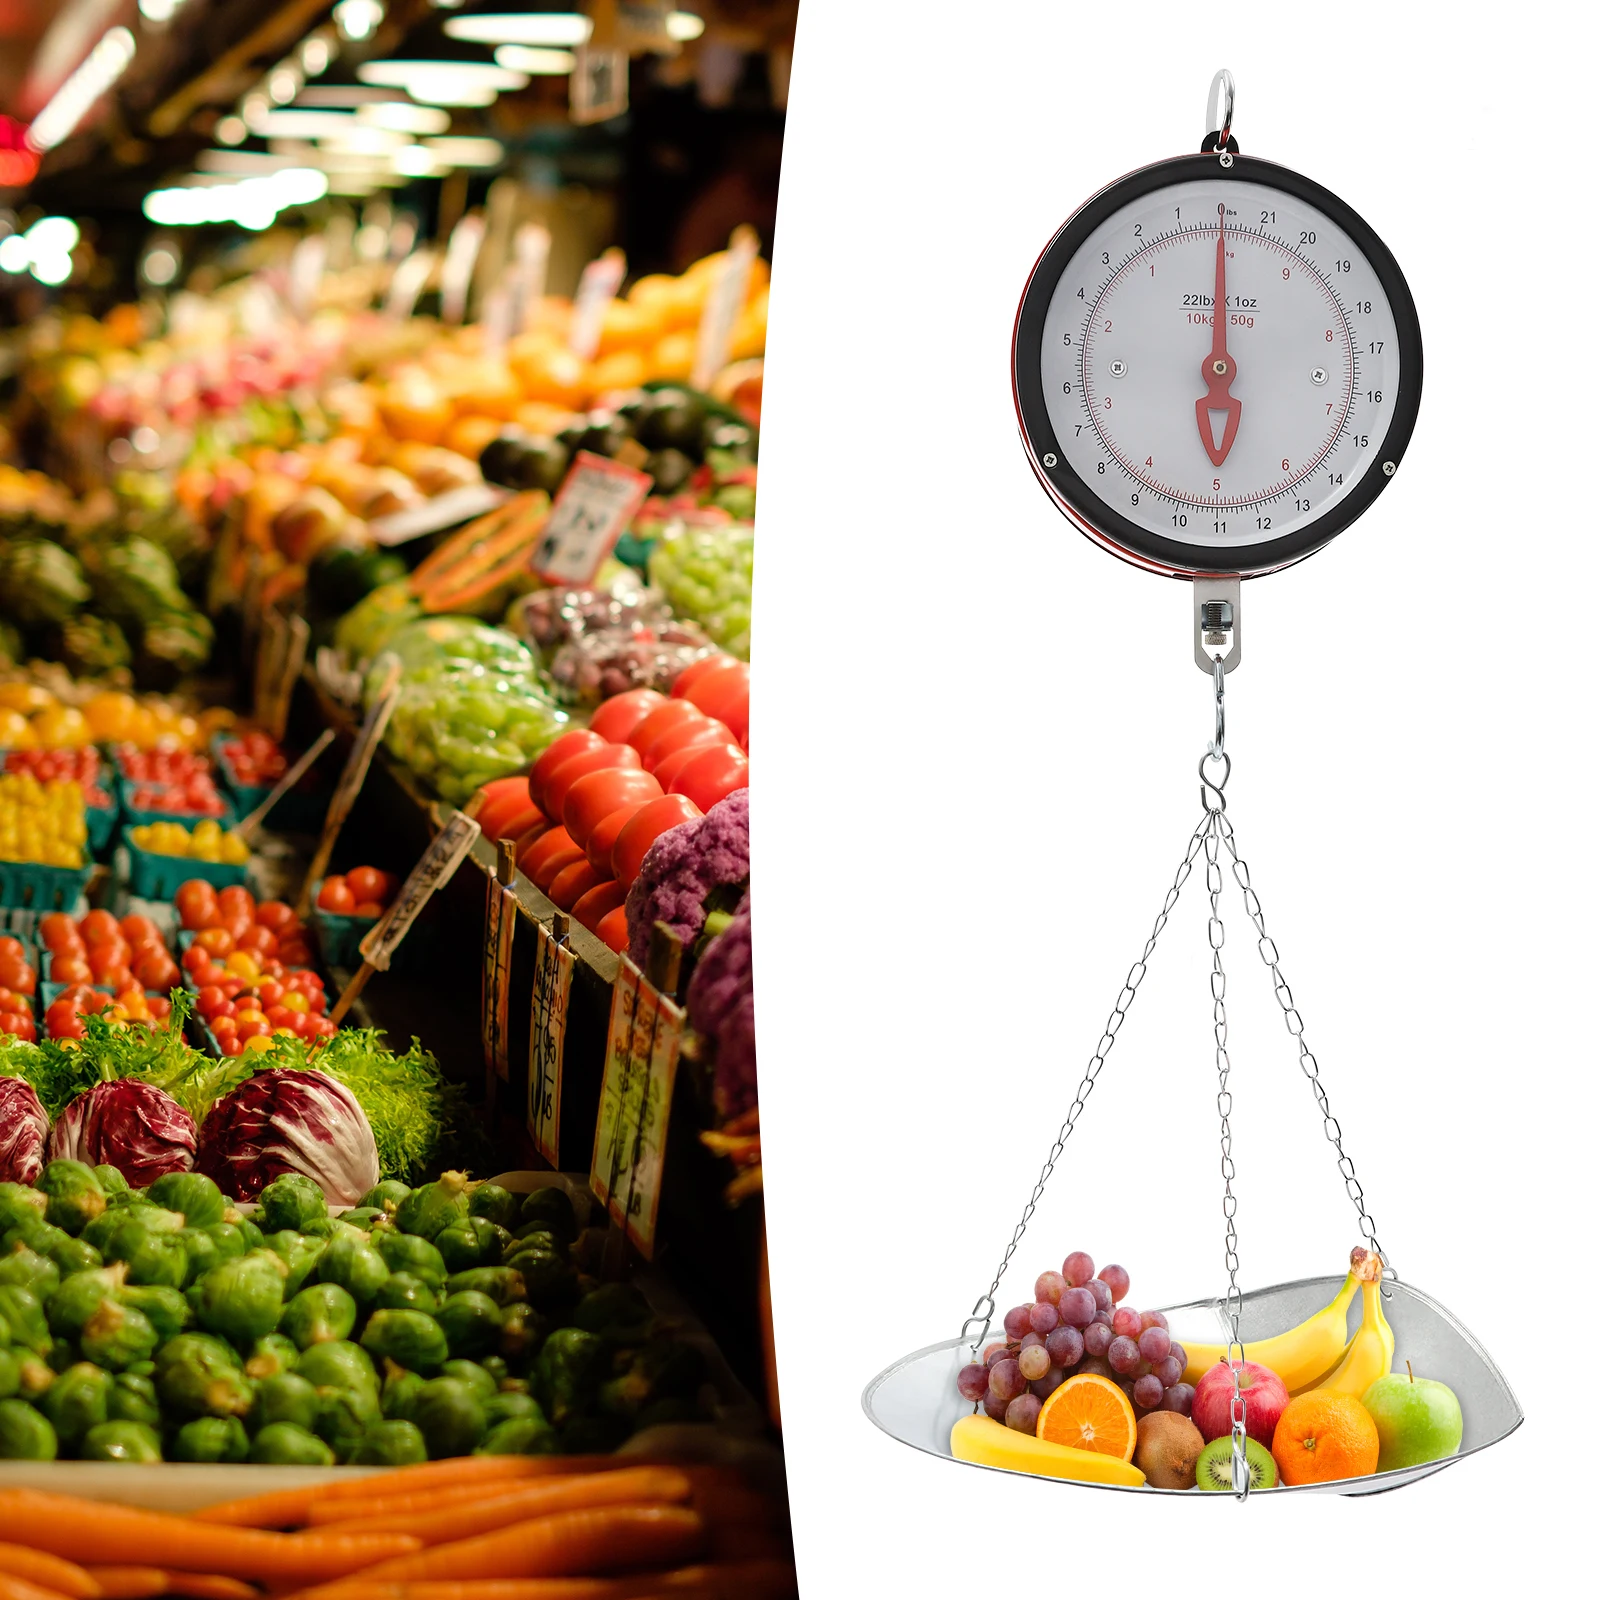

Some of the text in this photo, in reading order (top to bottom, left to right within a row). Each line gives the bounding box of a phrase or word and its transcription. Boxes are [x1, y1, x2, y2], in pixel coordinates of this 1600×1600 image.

[1175, 207, 1179, 219] 1
[1218, 203, 1225, 217] 0
[1261, 211, 1275, 223] 21
[1135, 224, 1142, 236] 2
[1299, 232, 1316, 245] 20
[1102, 252, 1109, 264] 3
[1150, 265, 1154, 276] 1
[1336, 260, 1350, 272] 19
[1283, 268, 1290, 280] 9
[1077, 288, 1084, 299] 4
[1235, 296, 1256, 307] 1oz
[1357, 302, 1371, 314] 18
[1105, 320, 1112, 332] 2
[1187, 313, 1253, 328] 10kg 50g
[1064, 334, 1071, 346] 5
[1326, 330, 1333, 342] 8
[1369, 342, 1384, 354] 17
[1063, 382, 1070, 394] 6
[1105, 397, 1111, 409] 3
[1367, 391, 1382, 403] 16
[1326, 404, 1332, 415] 7
[1075, 425, 1082, 437] 7
[1354, 436, 1368, 447] 15
[1145, 456, 1152, 467] 4
[1282, 459, 1289, 471] 6
[1098, 462, 1105, 474] 8
[1213, 479, 1220, 490] 5
[1329, 474, 1343, 485] 14
[1131, 494, 1140, 506] 9
[1295, 500, 1310, 511] 13
[1172, 515, 1187, 527] 10
[1256, 518, 1271, 529] 12
[1214, 522, 1225, 533] 11
